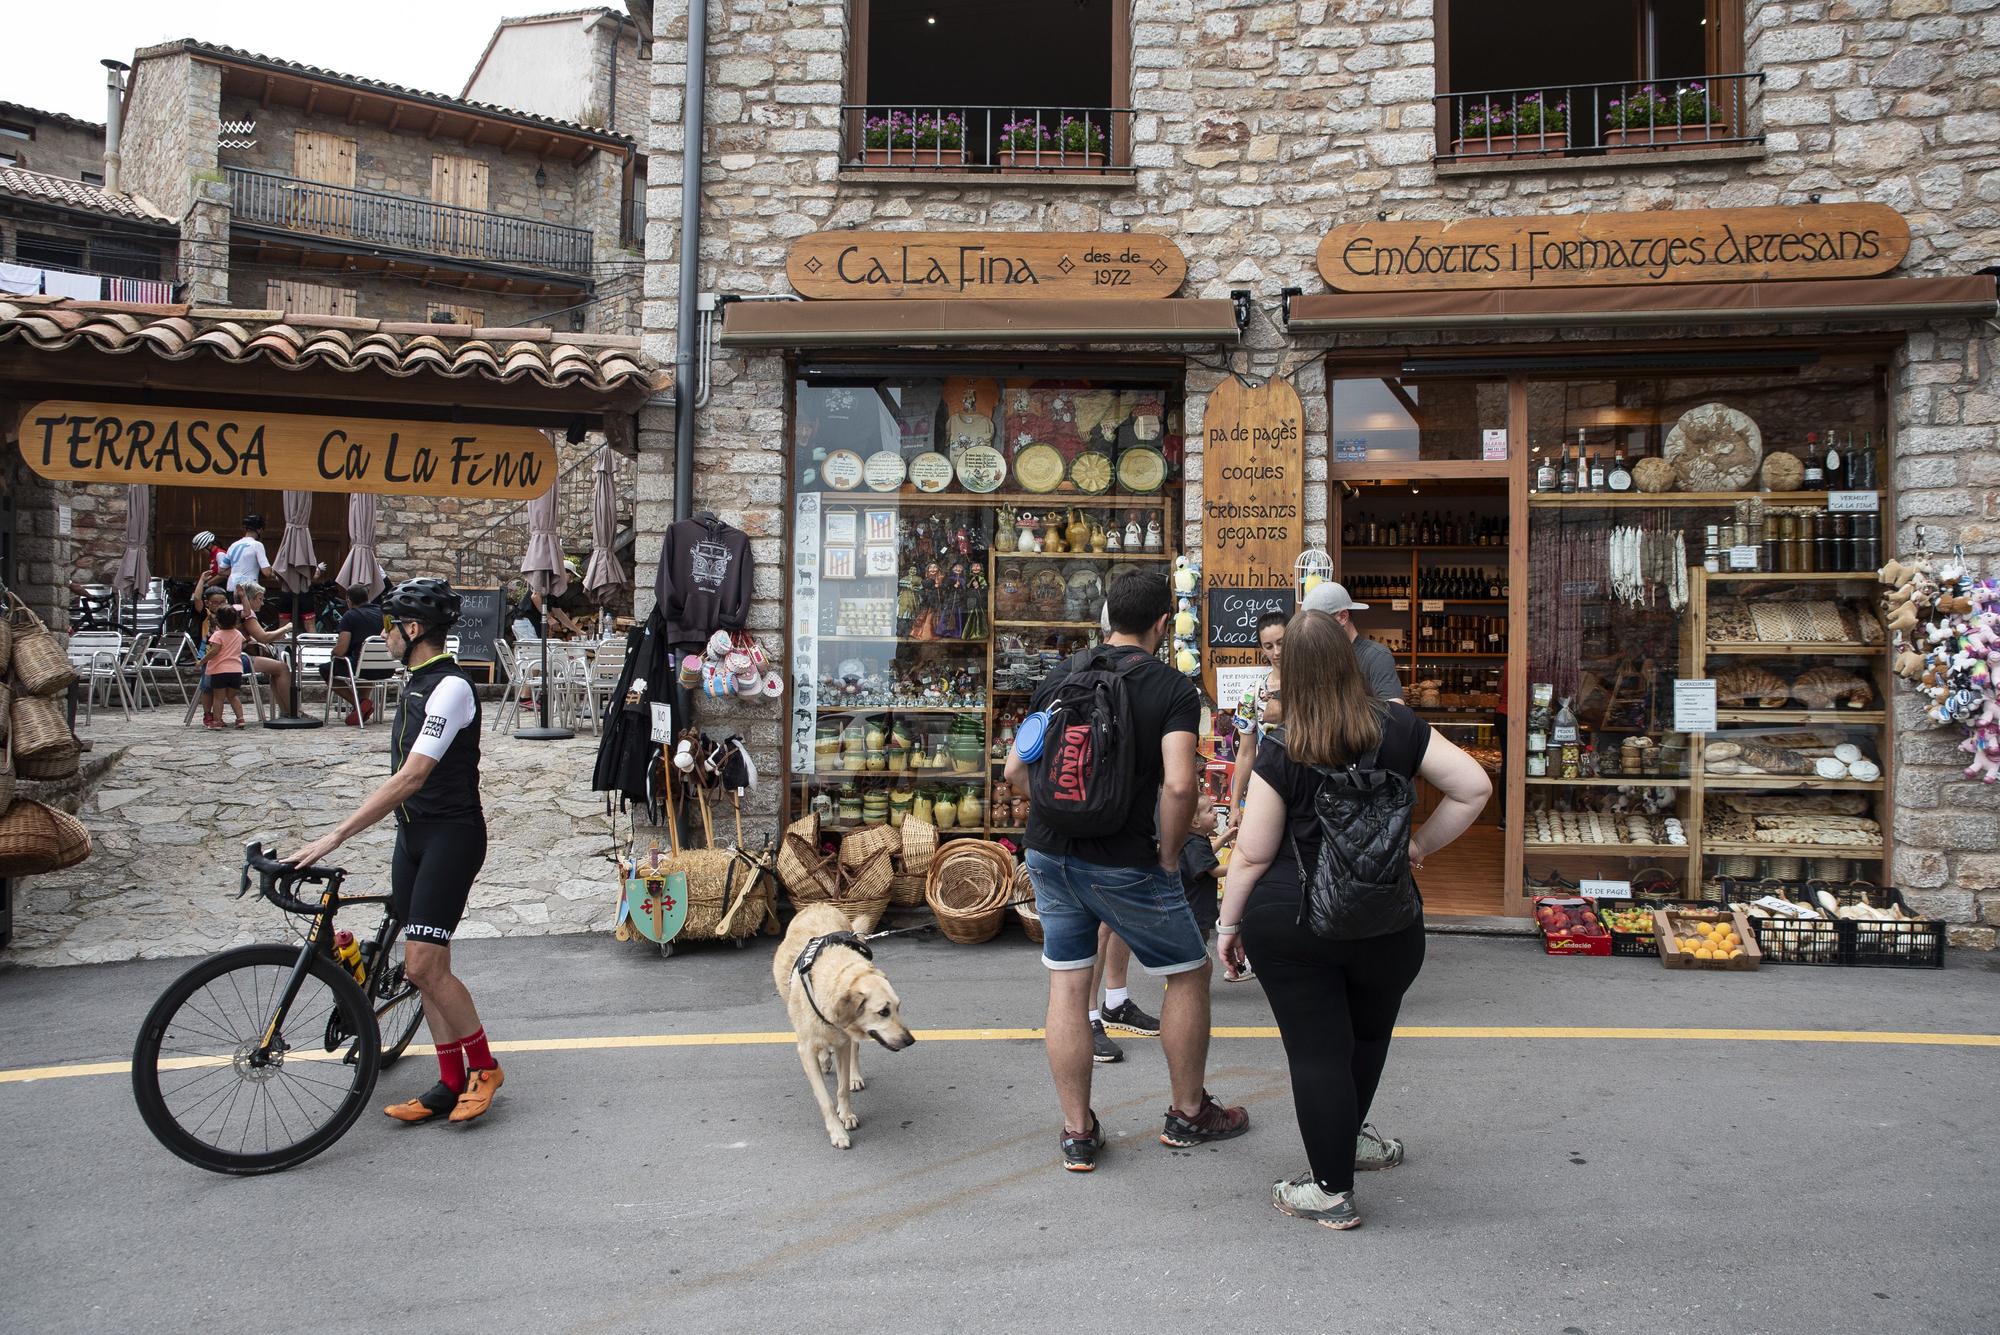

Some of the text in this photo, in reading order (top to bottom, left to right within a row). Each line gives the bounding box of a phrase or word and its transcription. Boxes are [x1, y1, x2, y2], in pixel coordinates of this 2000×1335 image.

[1083, 246, 1141, 263] des de
[1342, 224, 1880, 282] Embotits i Formatges Artesans
[837, 246, 1040, 292] Ca La Fina
[1092, 268, 1132, 286] 1972
[34, 412, 268, 477] TERRASSA
[1209, 421, 1297, 449] pa de pagès
[317, 429, 542, 488] Ca La Fina
[1221, 465, 1285, 487] coques
[1208, 504, 1297, 519] croissants
[1216, 525, 1288, 549] gegants
[1208, 567, 1294, 587] avui hi ha:
[1223, 594, 1283, 614] Coques
[456, 615, 483, 628] SOM
[1236, 611, 1258, 628] de
[468, 631, 481, 640] LA
[458, 644, 489, 654] OTIGA
[1209, 650, 1237, 669] forn
[1238, 650, 1253, 665] de
[802, 937, 824, 968] TINA
